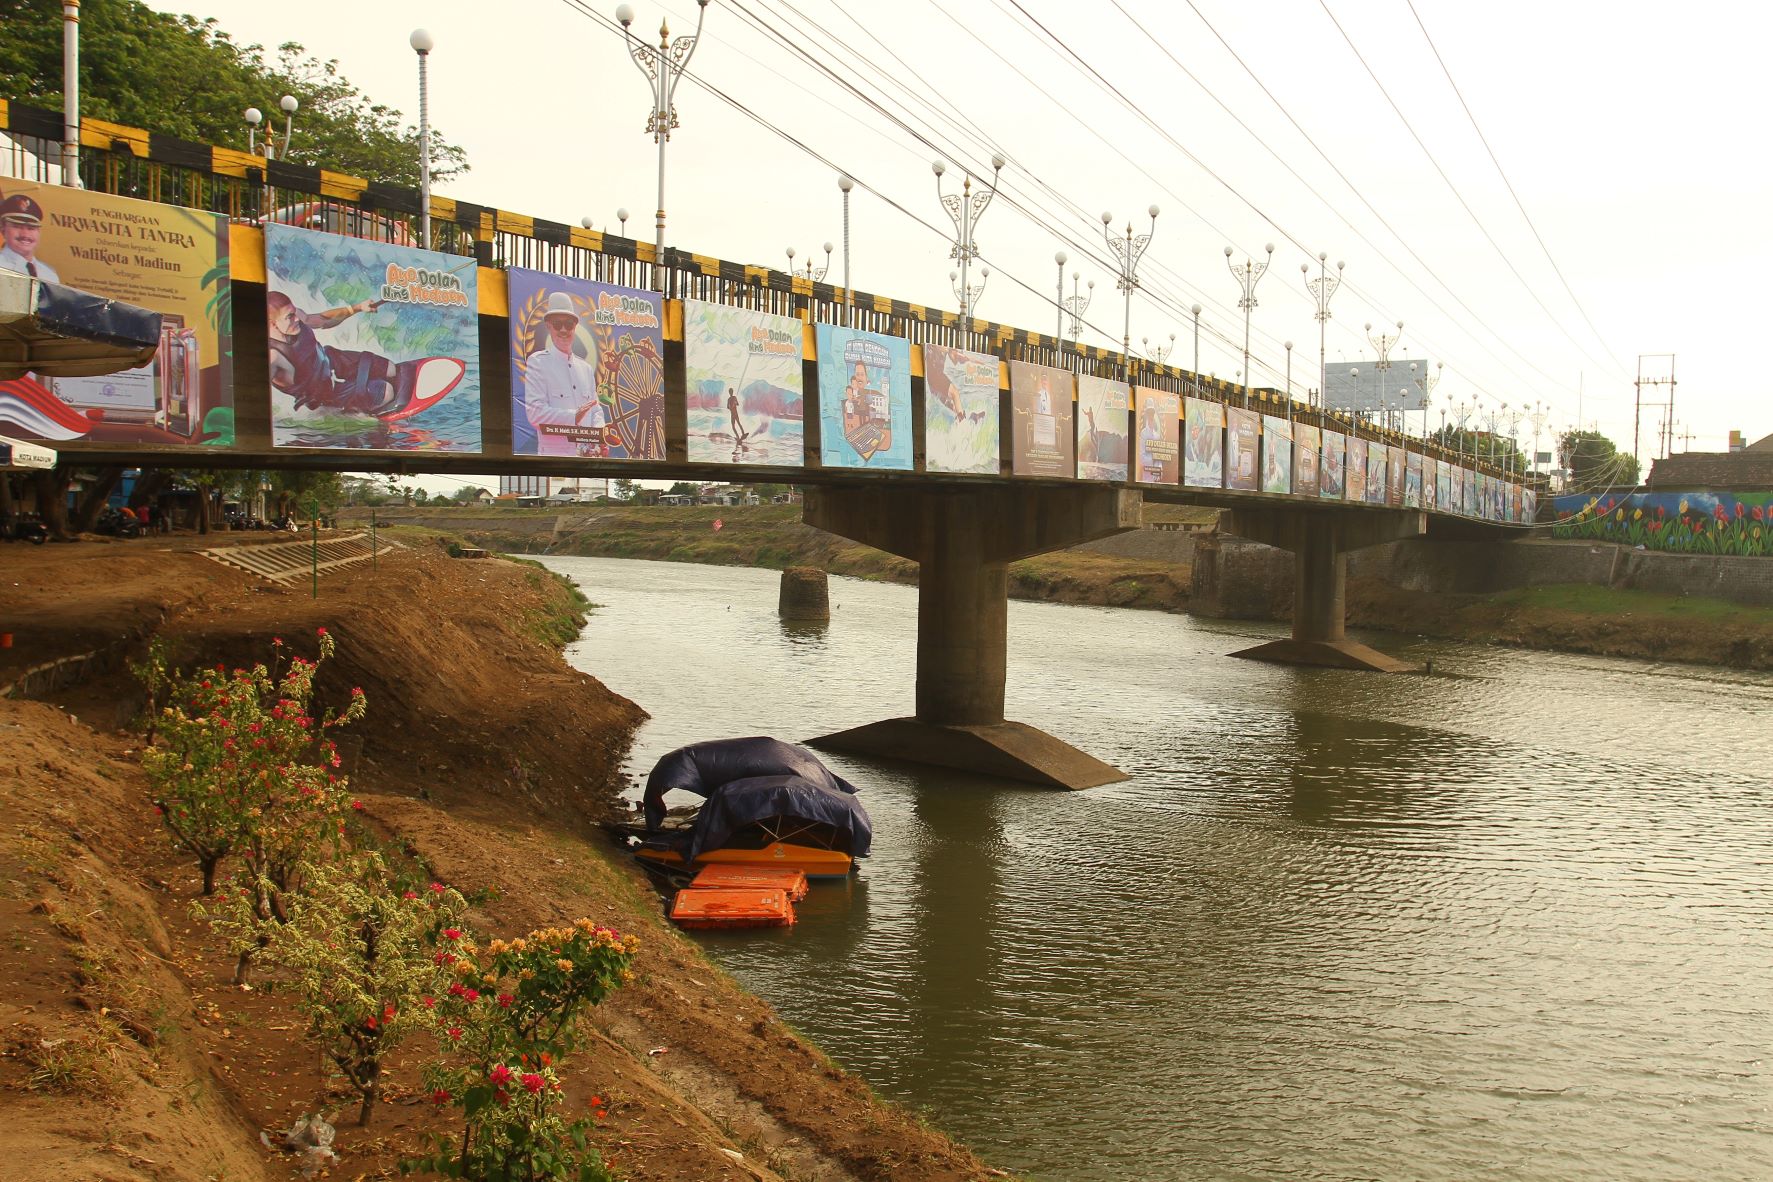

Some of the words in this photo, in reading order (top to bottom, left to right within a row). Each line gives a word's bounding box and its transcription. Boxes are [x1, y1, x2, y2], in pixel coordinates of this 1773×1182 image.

[50, 212, 133, 238] NIRWASITA
[139, 226, 196, 249] TANTRA
[91, 207, 160, 226] PENGHARGAAN
[69, 245, 129, 266] Walikota
[134, 254, 182, 273] Madiun
[386, 263, 417, 287] Ayo
[418, 269, 461, 291] Dolan
[621, 296, 654, 316] Dolan
